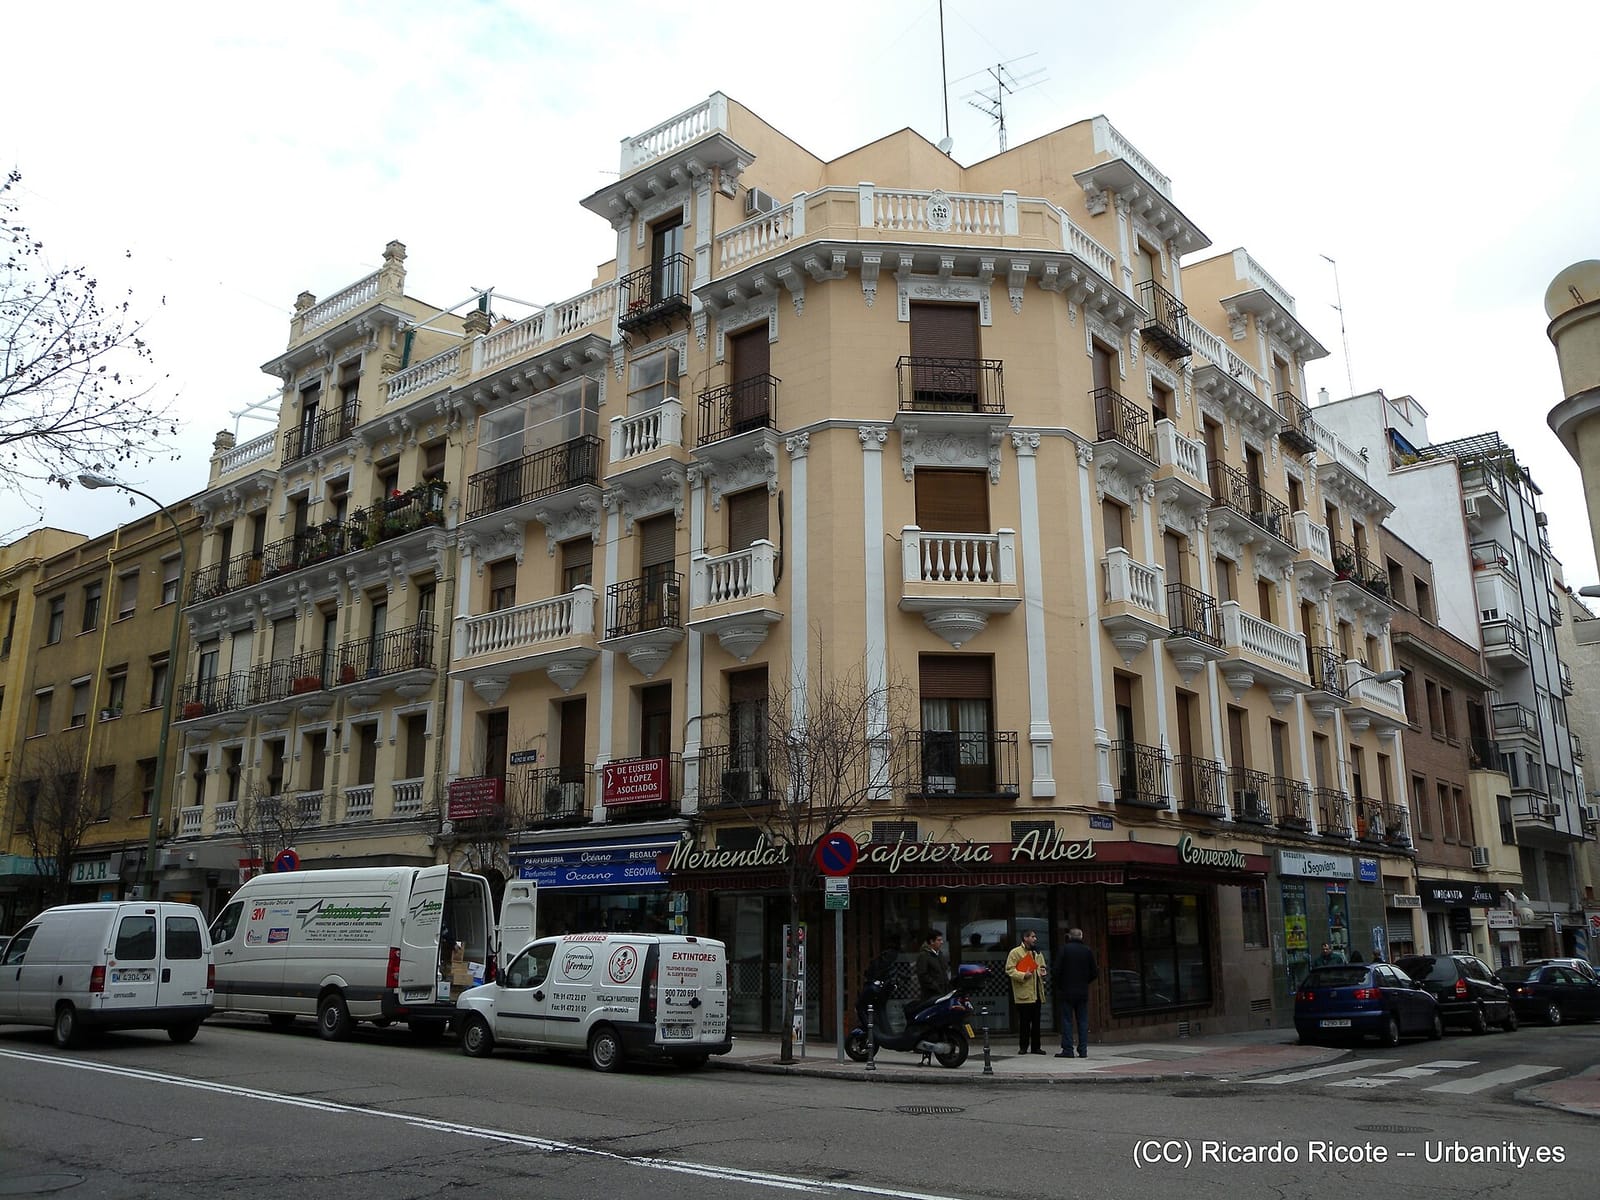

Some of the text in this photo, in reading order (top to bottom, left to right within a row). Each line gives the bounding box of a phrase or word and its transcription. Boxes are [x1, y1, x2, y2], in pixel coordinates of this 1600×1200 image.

[617, 763, 659, 775] DE EUSEBIO
[623, 773, 652, 784] Y LÓPEZ
[616, 783, 658, 795] ASOCIADOS
[665, 832, 790, 870] Meriendas
[1011, 828, 1097, 861] Albes
[853, 830, 994, 874] Cafeteria
[76, 861, 108, 881] BAR
[251, 907, 266, 921] 3M
[672, 952, 717, 962] EXTINTORES
[665, 988, 676, 998] 900
[676, 988, 687, 998] 720
